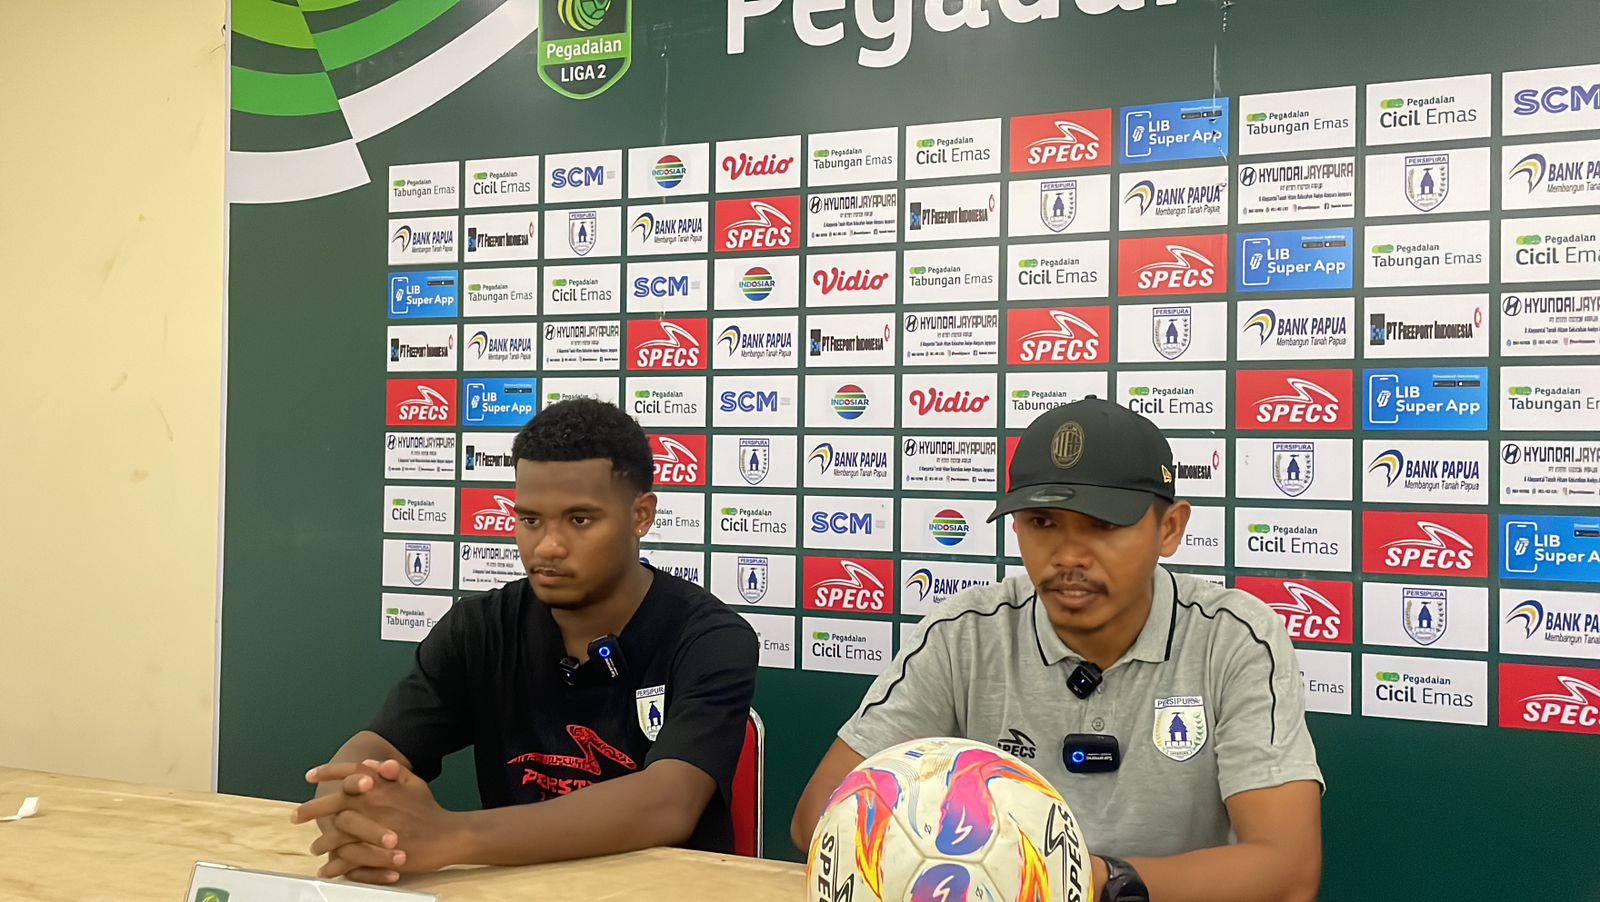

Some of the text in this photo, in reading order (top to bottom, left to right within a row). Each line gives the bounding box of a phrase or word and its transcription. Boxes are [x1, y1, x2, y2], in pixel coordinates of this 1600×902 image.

[546, 38, 622, 60] Pegadaian
[561, 64, 606, 82] LIGA 2
[1408, 96, 1454, 107] Pegadaian
[1514, 84, 1600, 115] SCM
[1269, 110, 1309, 120] Pegadaian
[1380, 108, 1476, 128] Cicil Emas
[1149, 120, 1170, 132] LIB
[1246, 118, 1348, 135] Tabungan Emas
[937, 137, 973, 146] Pegadaian
[1150, 130, 1222, 148] Super App
[831, 148, 862, 156] Pegadaian
[916, 148, 990, 164] Cicil Emas
[1028, 142, 1099, 164] SPECS
[722, 153, 794, 180] Vidio
[814, 155, 892, 169] Tabungan Emas
[552, 166, 603, 188] SCM
[652, 167, 686, 176] INDOSIAR
[1548, 162, 1583, 181] BANK
[474, 181, 530, 194] Cicil Emas
[1156, 184, 1220, 205] BANK PAPUA
[922, 210, 930, 225] PT
[655, 218, 702, 234] BANK PAPUA
[726, 226, 791, 248] SPECS
[1545, 234, 1595, 245] Pegadaian
[1268, 249, 1289, 260] LIB
[1397, 244, 1439, 253] Pegadaian
[1516, 248, 1559, 265] Cicil
[1041, 258, 1079, 267] Pegadaian
[1268, 260, 1345, 276] Super App
[1372, 253, 1482, 268] Tabungan Emas
[739, 280, 775, 288] INDOSIAR
[813, 267, 888, 295] Vidio
[910, 274, 992, 288] Tabungan Emas
[1019, 269, 1097, 285] Cicil Emas
[1138, 269, 1214, 288] SPECS
[634, 276, 688, 297] SCM
[1278, 317, 1346, 335] BANK PAPUA
[1386, 322, 1397, 340] PT
[742, 333, 791, 348] BANK PAPUA
[1020, 338, 1098, 360] SPECS
[638, 348, 699, 367] SPECS
[482, 392, 496, 401] LIB
[1153, 388, 1194, 396] Pegadaian
[1396, 386, 1420, 398] LIB
[1535, 388, 1580, 396] Pegadaian
[483, 401, 532, 414] Super App
[635, 400, 696, 413] Cicil Emas
[720, 391, 777, 412] SCM
[910, 388, 989, 416] Vidio
[1127, 398, 1213, 415] Cicil Emas
[1396, 400, 1480, 415] Super App
[1508, 396, 1580, 412] Tabungan
[399, 405, 448, 420] SPECS
[1257, 402, 1338, 422] SPECS
[834, 452, 886, 468] BANK PAPUA
[654, 464, 697, 482] PECS
[1406, 460, 1479, 479] BANK PAPUA
[740, 508, 772, 517] Pegadaian
[474, 516, 515, 532] SPEC
[721, 518, 786, 533] Cicil Emas
[811, 512, 872, 534] SCM
[929, 523, 969, 532] INDOSIAR
[1274, 526, 1317, 535] Pegadaian
[1186, 534, 1218, 546] Emas
[1248, 536, 1338, 555] Cicil Emas
[1535, 534, 1560, 547] LIB
[1386, 547, 1473, 569] SPECS
[1535, 549, 1585, 565] Super
[934, 579, 958, 594] BANK
[815, 588, 884, 610] SPECS
[1546, 612, 1580, 631] BANK
[764, 640, 789, 651] Emas
[832, 634, 866, 642] Pegadaian
[812, 643, 882, 661] Cicil Emas
[1404, 674, 1450, 684] Pegadaian
[1376, 684, 1472, 707] Cicil Emas
[1524, 702, 1600, 726] SPEC
[818, 832, 834, 902] SPE
